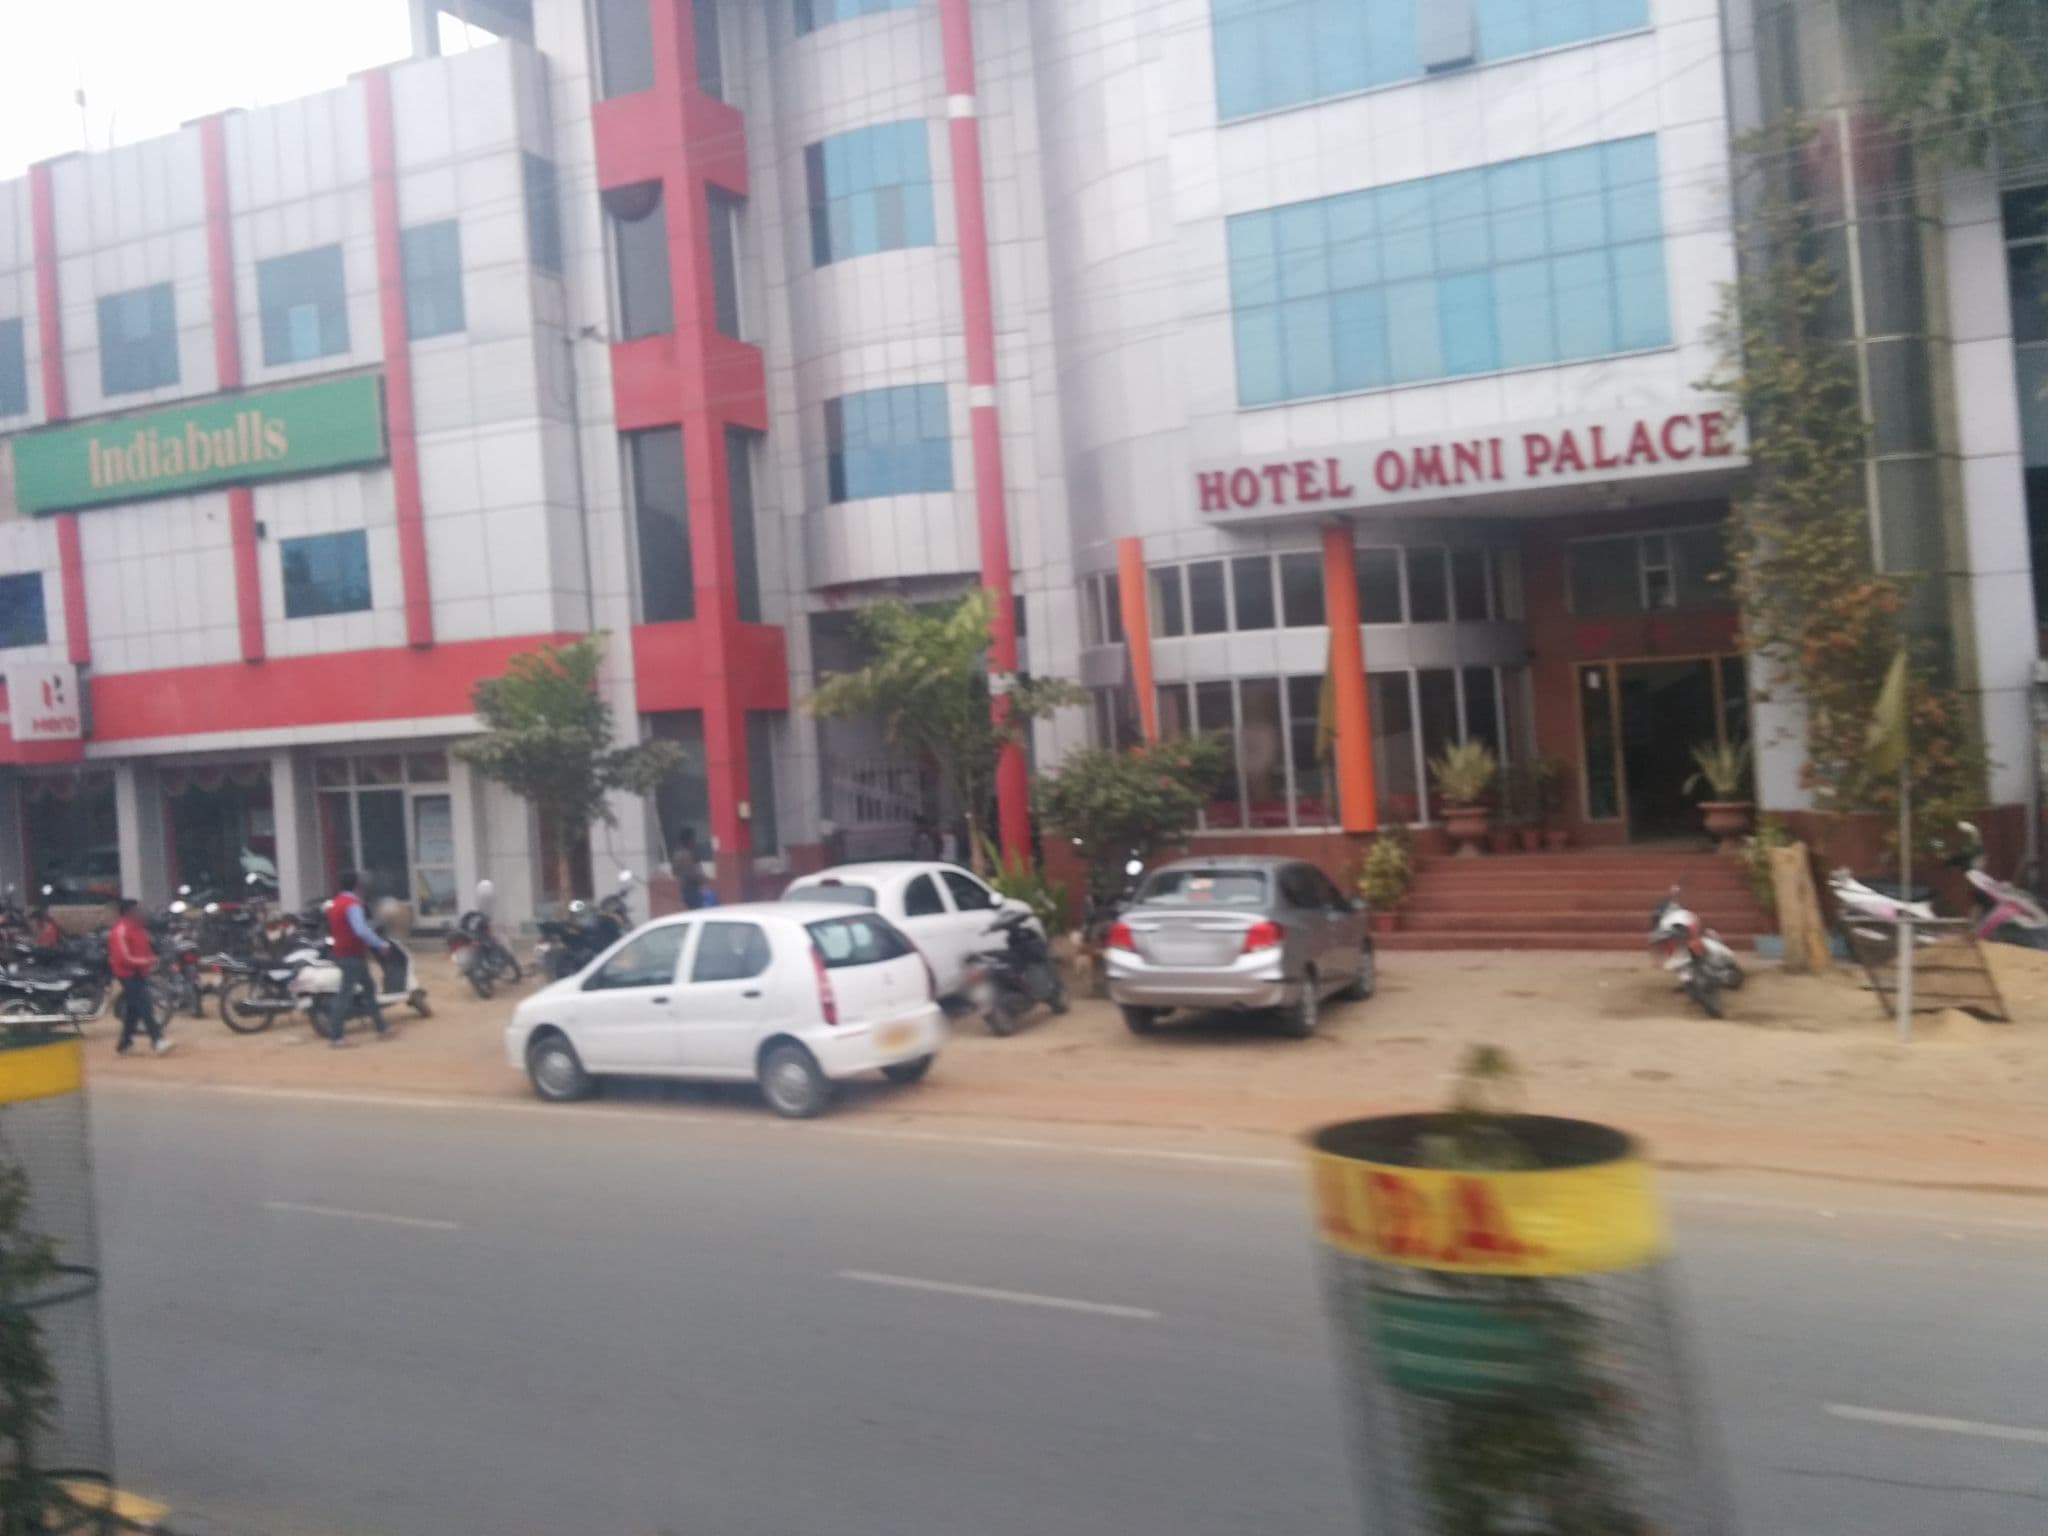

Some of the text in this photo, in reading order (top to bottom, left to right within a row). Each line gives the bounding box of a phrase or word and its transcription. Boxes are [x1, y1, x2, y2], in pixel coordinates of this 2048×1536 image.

[89, 410, 290, 489] Indiabulls
[1195, 409, 1733, 512] HOTEL OMNI PALACE
